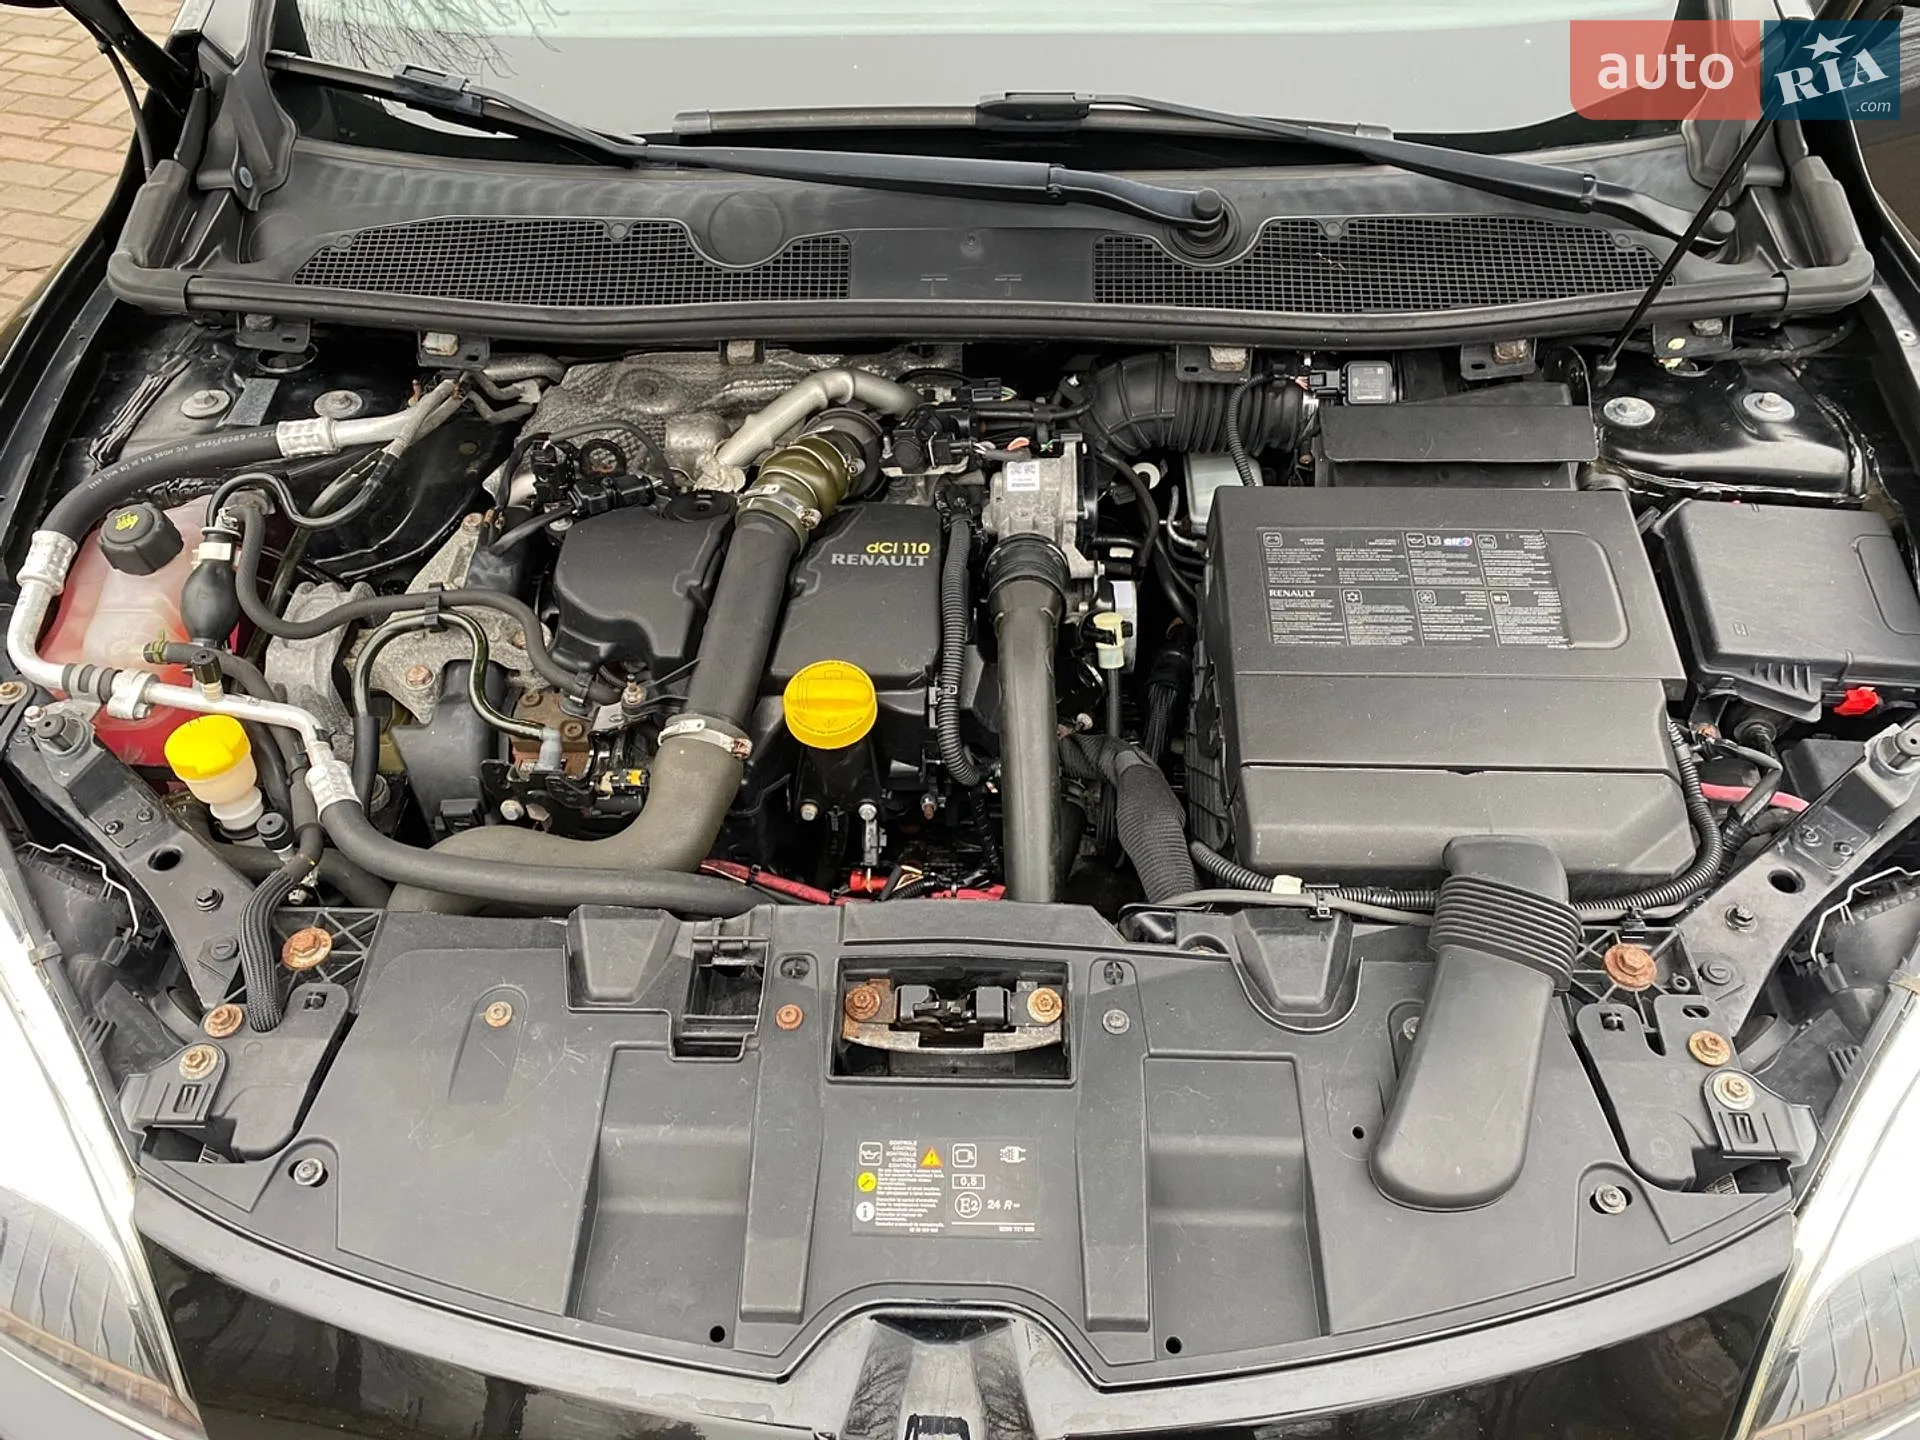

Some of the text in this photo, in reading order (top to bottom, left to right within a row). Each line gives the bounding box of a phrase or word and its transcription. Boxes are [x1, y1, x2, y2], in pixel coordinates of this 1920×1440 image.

[902, 542, 931, 555] 110
[831, 553, 929, 567] RENAULT
[1268, 589, 1316, 598] RENAULT
[986, 1199, 1001, 1210] 24
